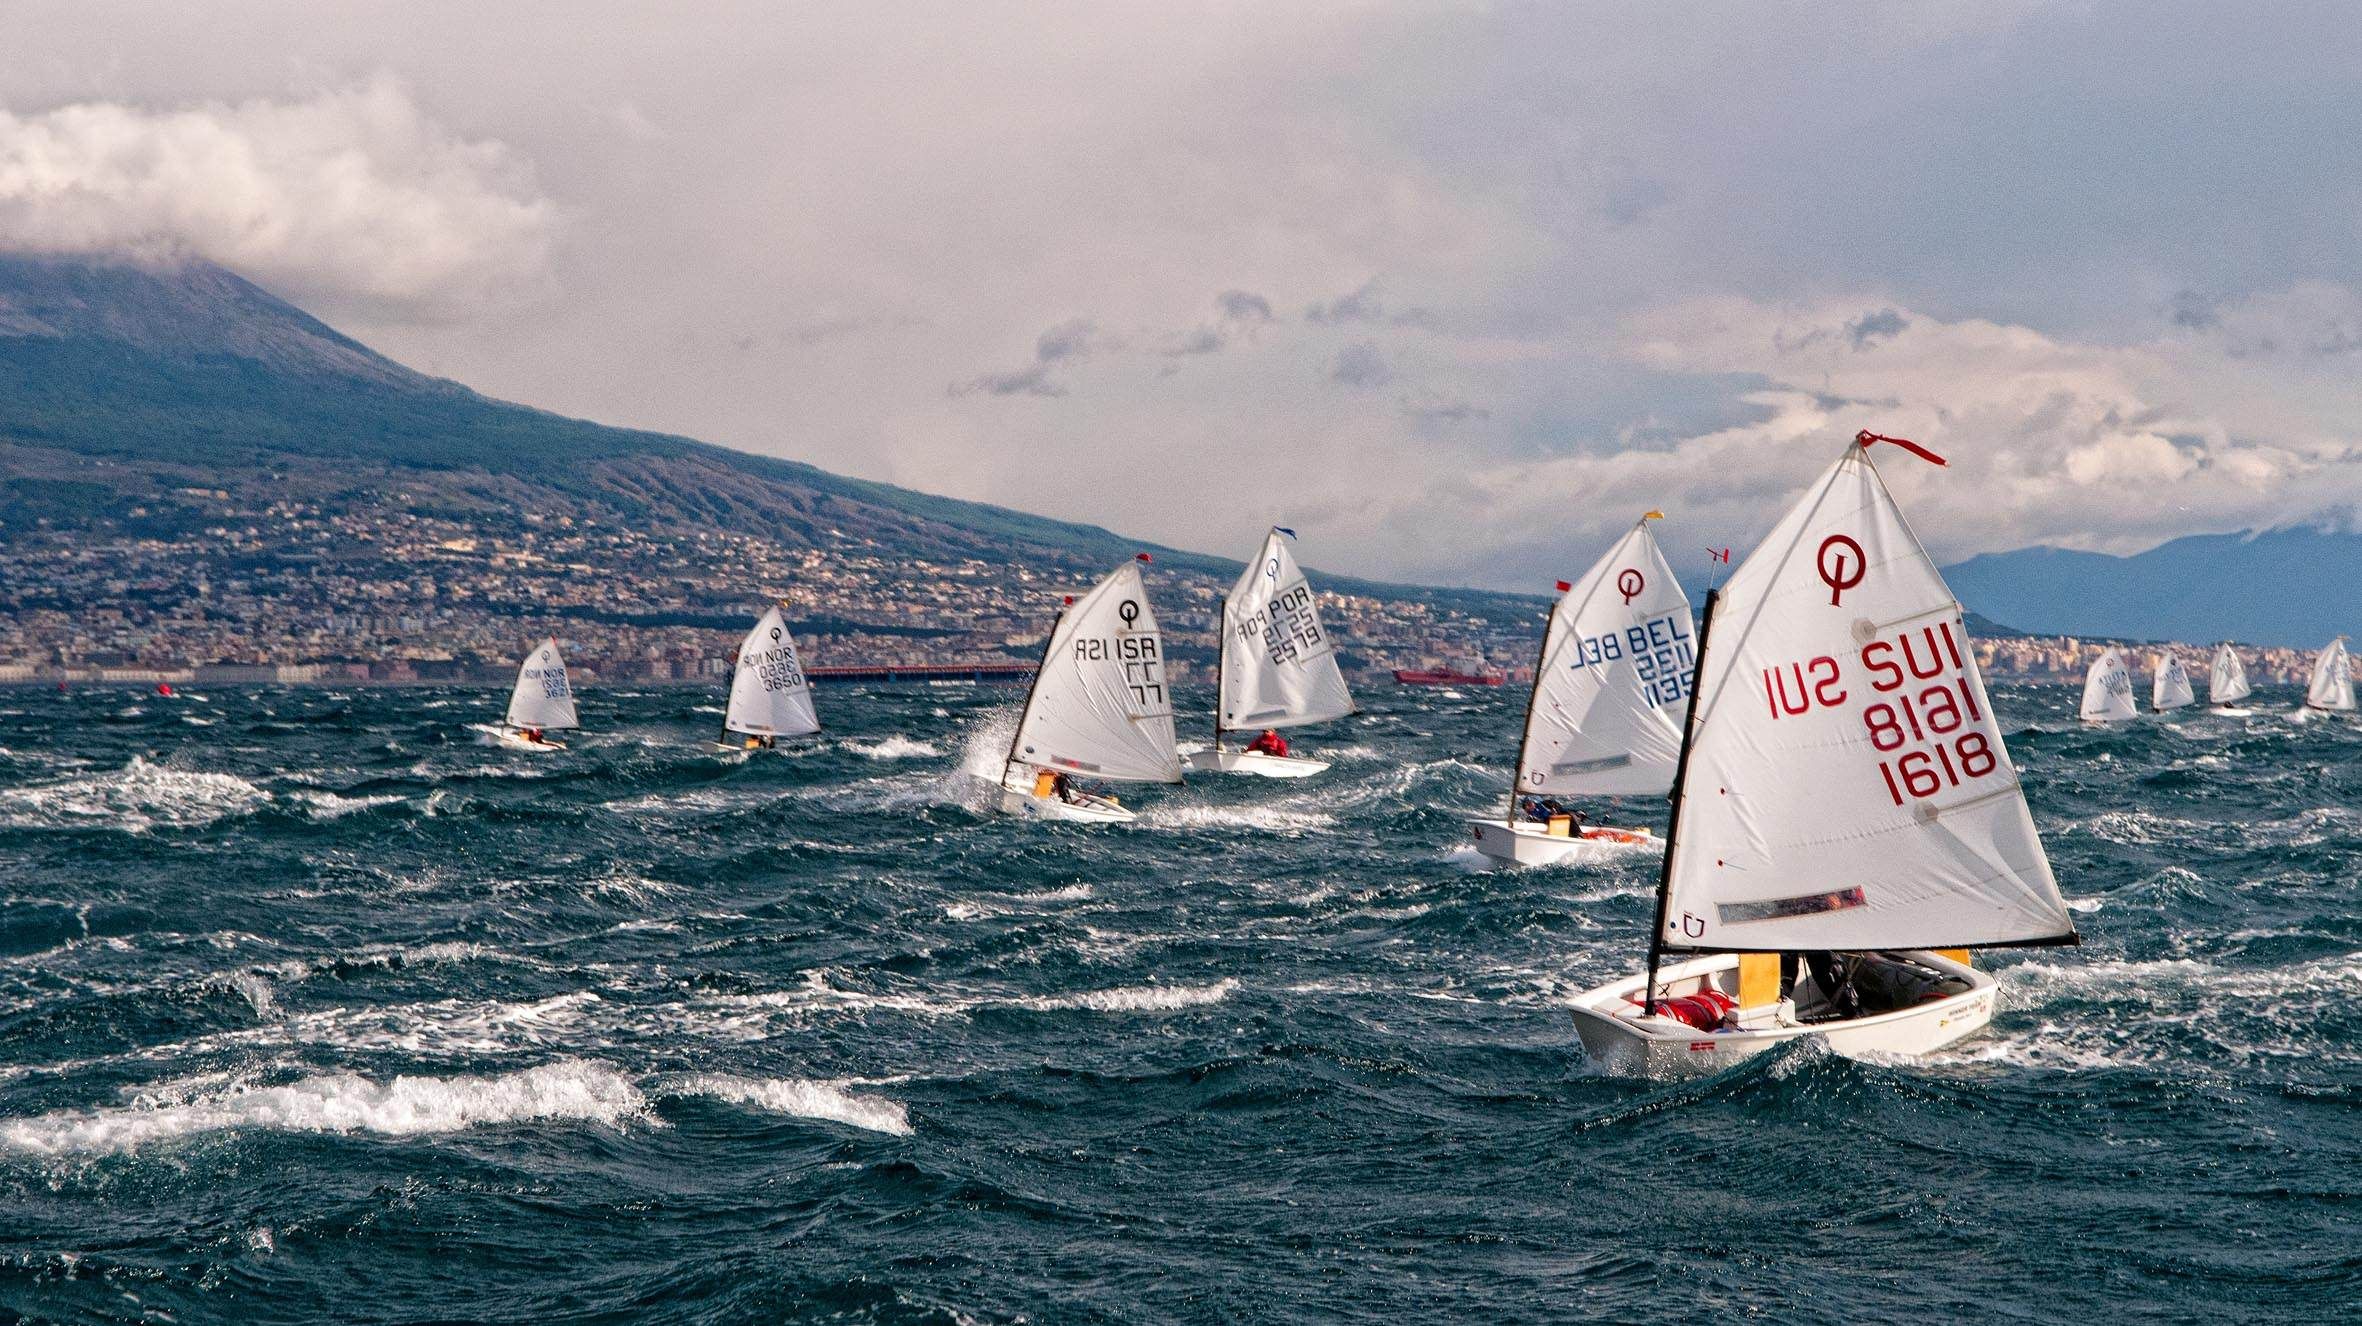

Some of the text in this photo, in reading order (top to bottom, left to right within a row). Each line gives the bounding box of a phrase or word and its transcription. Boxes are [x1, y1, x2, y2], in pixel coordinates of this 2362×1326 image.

[1268, 587, 1310, 620] POR
[1116, 637, 1156, 660] ISR
[1268, 625, 1321, 666] 2579
[1627, 616, 1690, 654] BEL
[765, 646, 793, 664] NOR
[1861, 622, 1963, 692] SUI
[544, 666, 565, 678] NOR
[764, 673, 801, 692] 3650
[1129, 685, 1162, 705] 77
[1644, 670, 1696, 709] 1135
[1879, 732, 1996, 806] 1618
